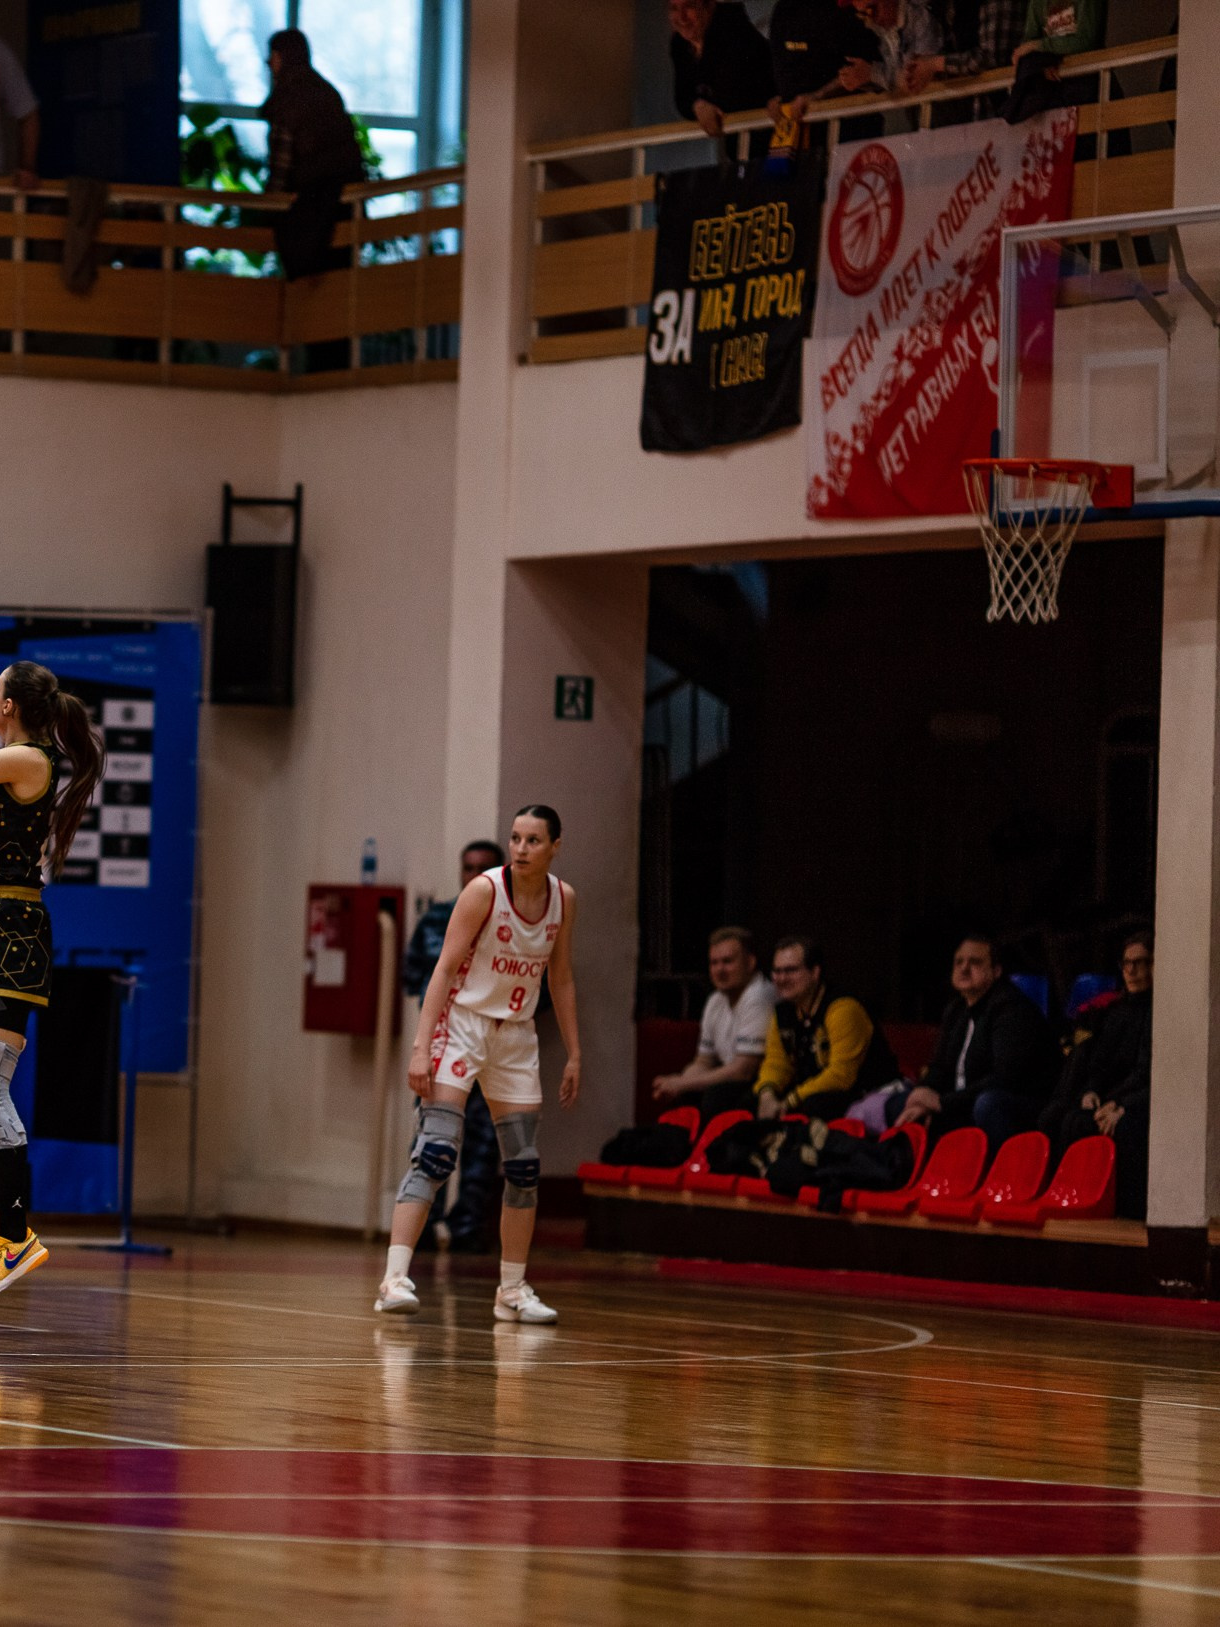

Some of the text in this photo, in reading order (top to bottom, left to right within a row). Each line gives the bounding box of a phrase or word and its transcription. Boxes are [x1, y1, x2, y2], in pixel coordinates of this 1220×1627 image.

[649, 288, 696, 366] ЗА
[743, 269, 805, 322] ГОРОД
[820, 141, 1001, 413] ВСЕГДА ИДЕТ К ПОБЕДЕ
[905, 321, 977, 444] РАВНЫХ
[508, 986, 526, 1012] 9
